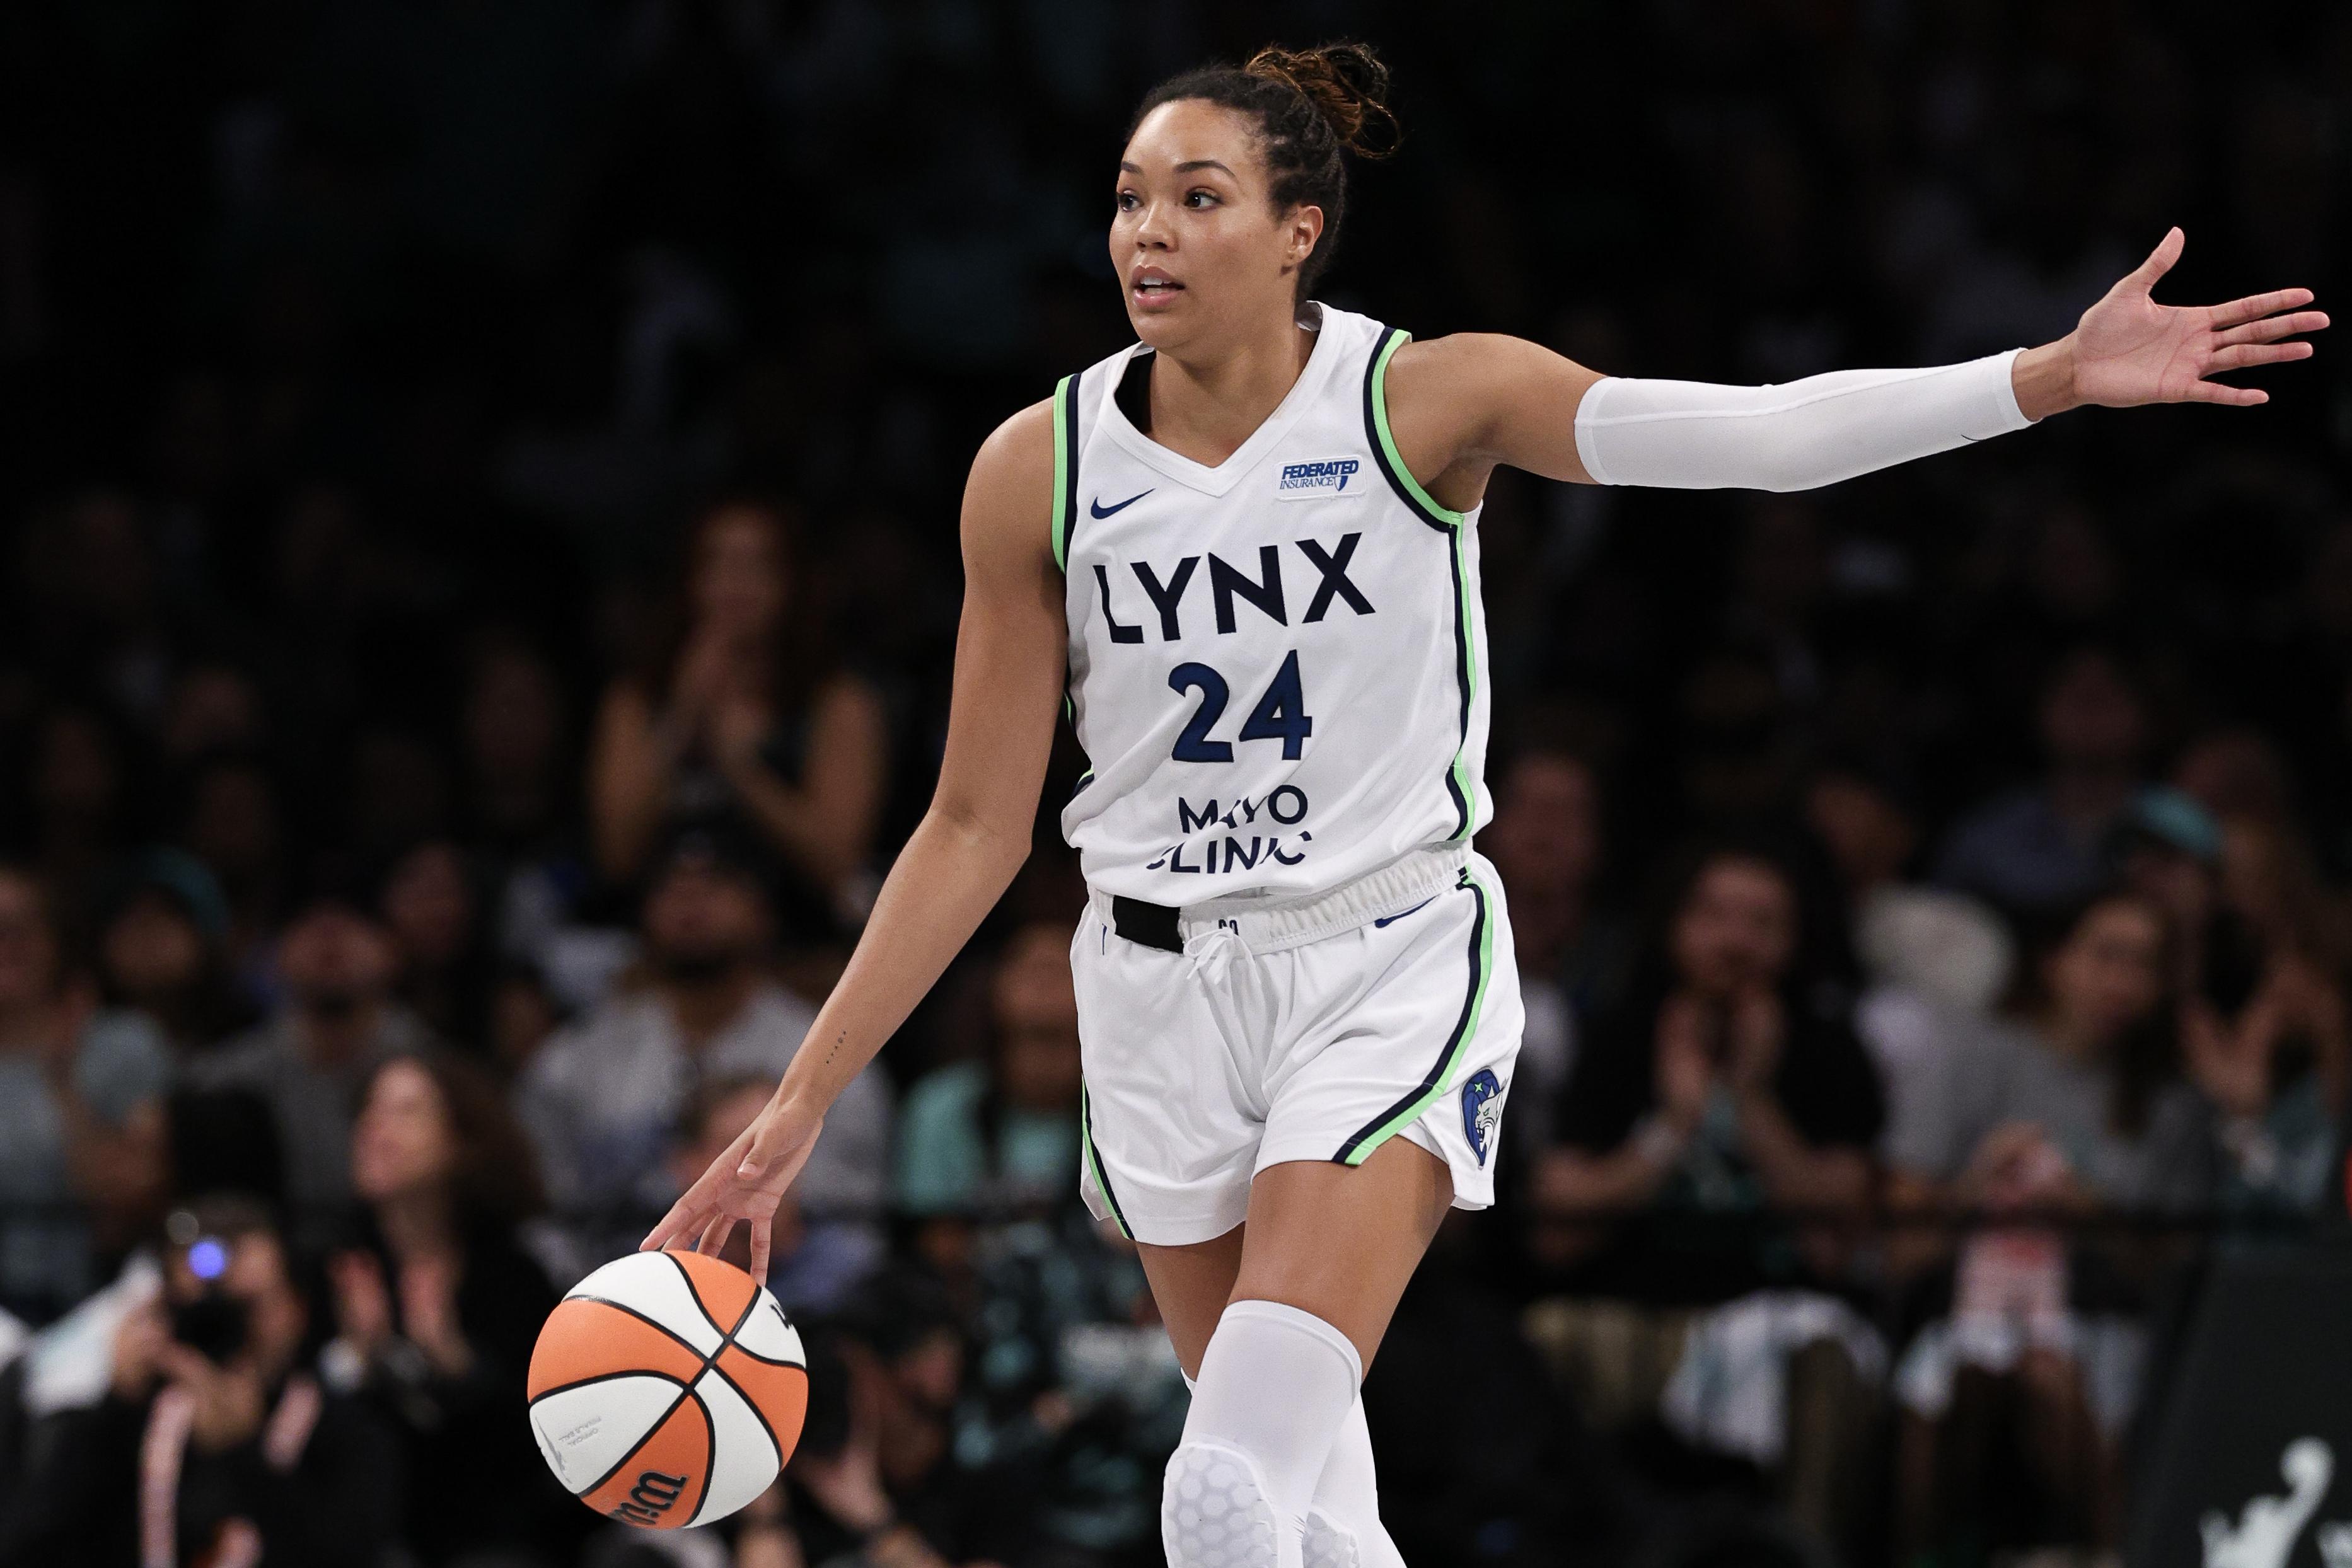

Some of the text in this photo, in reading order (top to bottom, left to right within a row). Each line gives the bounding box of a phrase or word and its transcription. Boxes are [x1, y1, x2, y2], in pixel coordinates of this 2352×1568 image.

[1280, 476, 1335, 490] INSURANCE
[1282, 460, 1359, 480] FEDERATED
[1092, 532, 1376, 644] LYNX
[1168, 649, 1312, 763] 24
[608, 1471, 688, 1525] Wil
